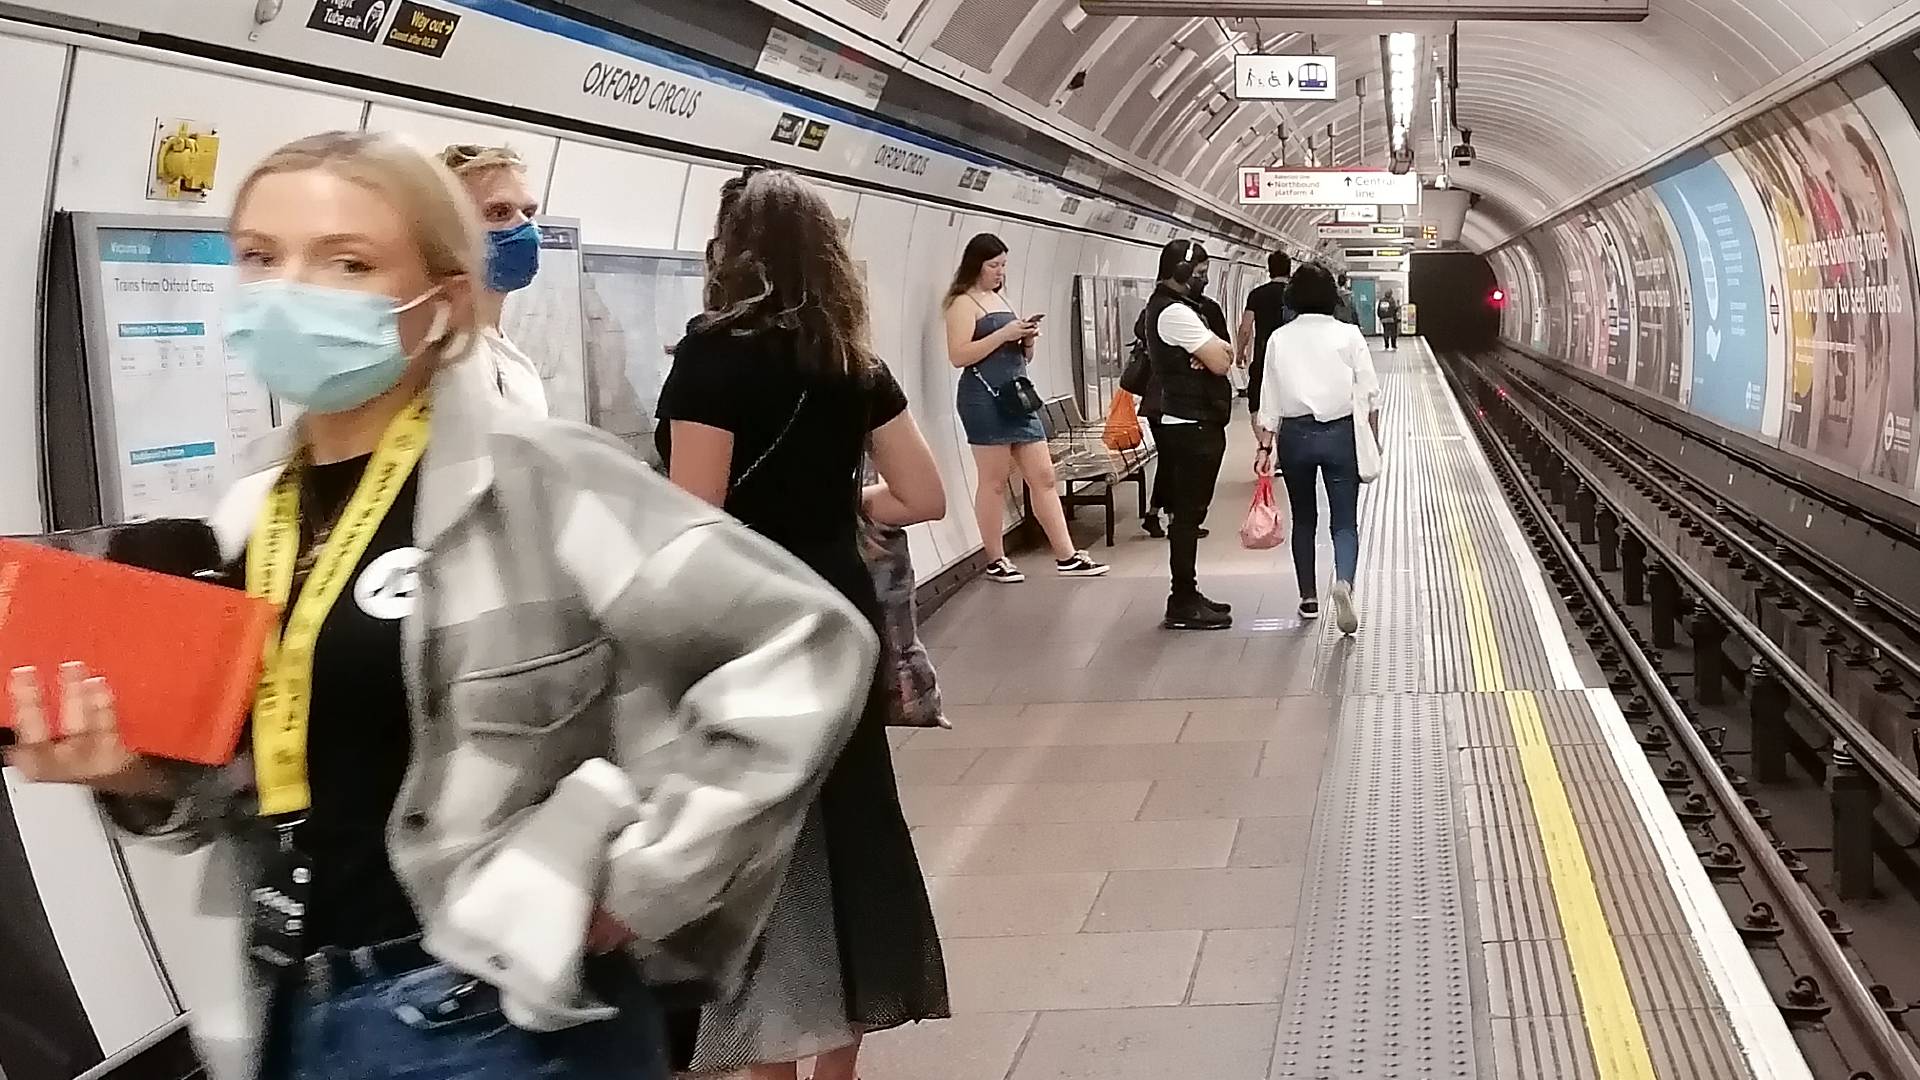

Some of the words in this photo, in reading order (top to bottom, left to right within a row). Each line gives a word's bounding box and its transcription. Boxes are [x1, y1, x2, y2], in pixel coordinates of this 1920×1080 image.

[323, 8, 345, 26] Tube
[343, 15, 362, 29] exit
[410, 10, 430, 32] Way
[429, 19, 446, 34] out
[583, 61, 650, 105] OXFORD
[648, 80, 702, 119] CIRCUS
[1355, 176, 1396, 186] Central
[1275, 189, 1307, 197] platform
[1355, 189, 1375, 198] line
[1827, 229, 1866, 271] thinking
[1862, 228, 1888, 261] time
[114, 277, 139, 292] Trains
[141, 277, 160, 292] from
[162, 277, 189, 292] Oxford
[191, 278, 214, 292] Circus
[1821, 287, 1838, 321] way
[1837, 280, 1849, 314] to
[1849, 287, 1867, 314] see
[1867, 276, 1902, 313] friends
